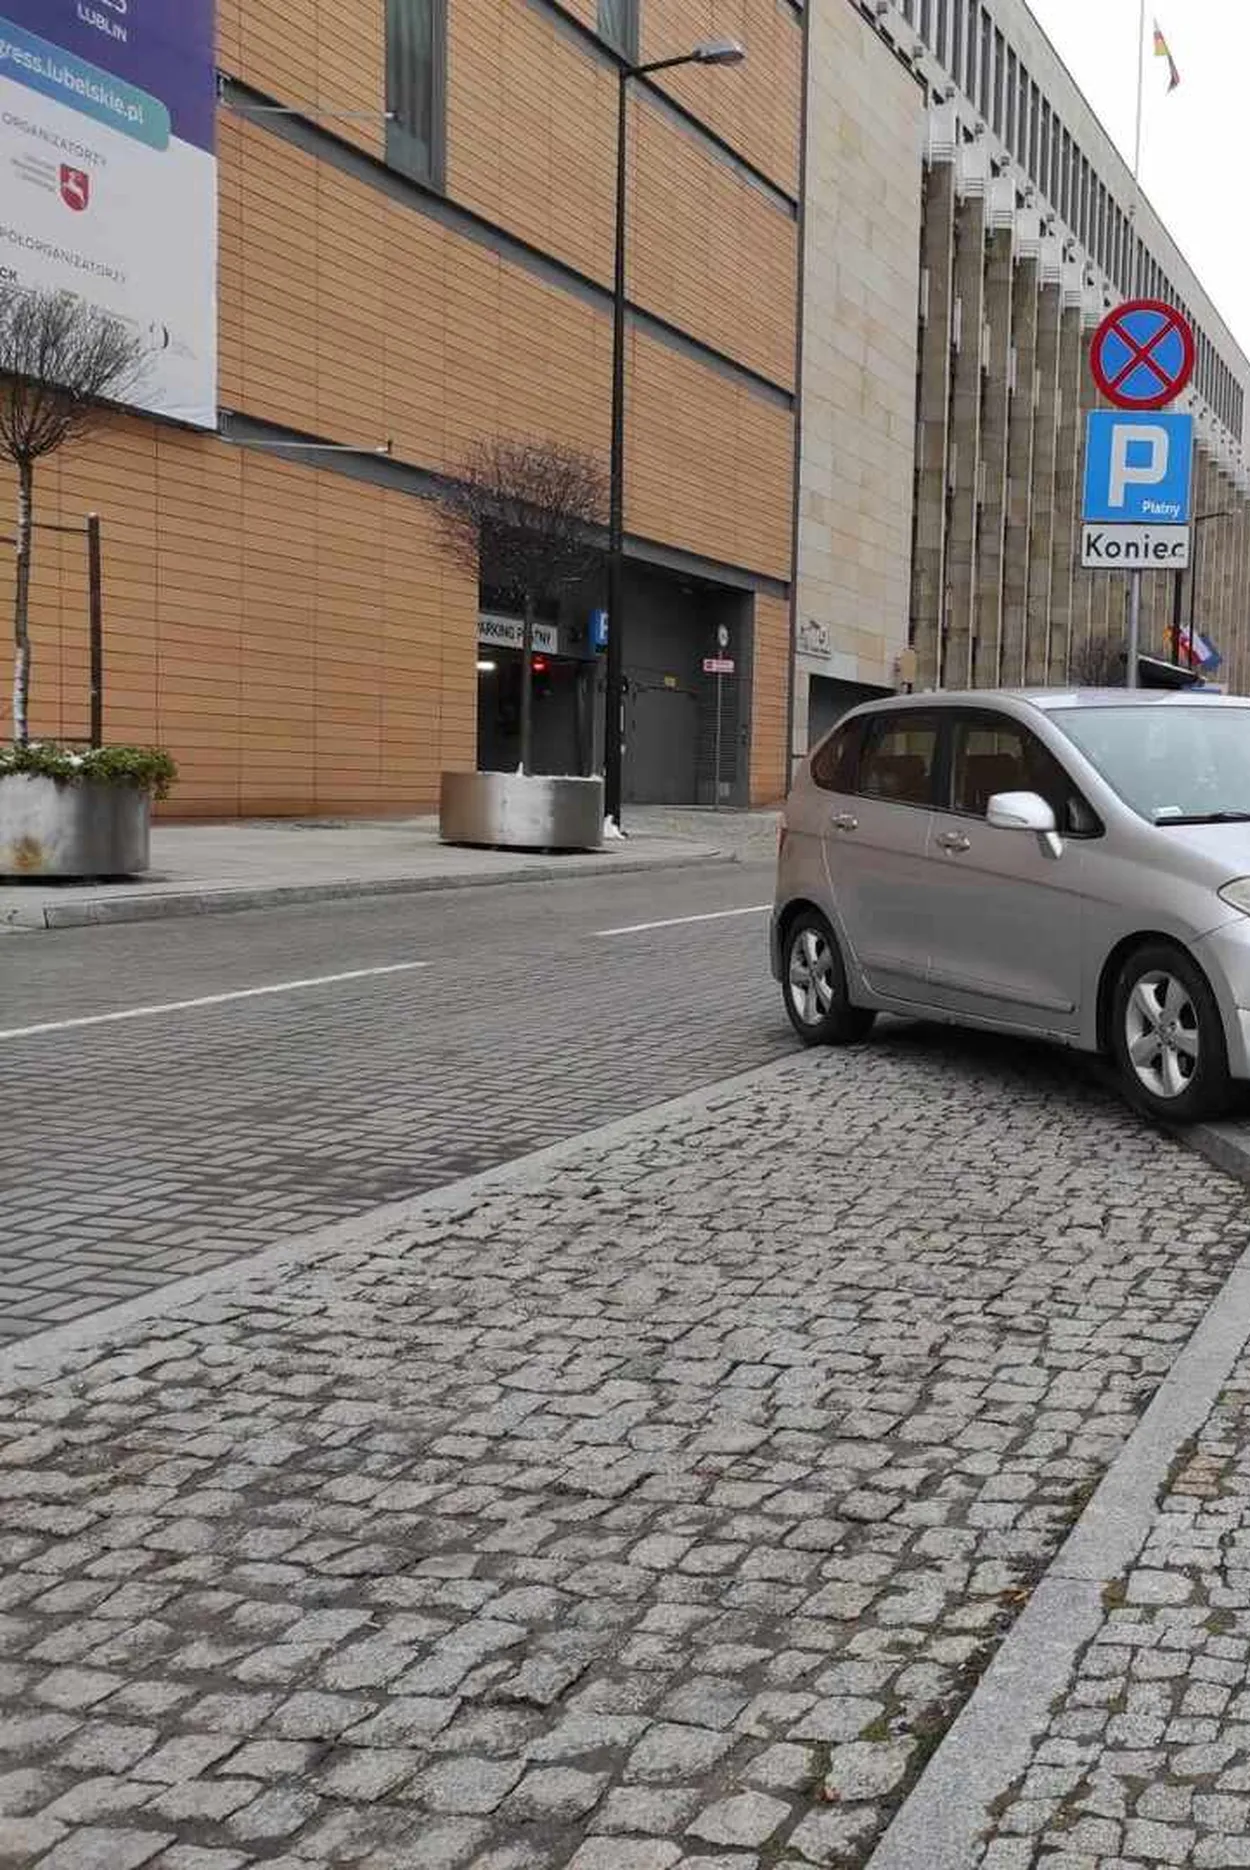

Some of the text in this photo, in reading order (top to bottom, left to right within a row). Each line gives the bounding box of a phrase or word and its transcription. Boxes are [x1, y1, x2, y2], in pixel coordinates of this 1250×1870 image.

[77, 3, 127, 42] LUBLIN
[1107, 425, 1169, 507] P
[1086, 533, 1184, 559] Koniec
